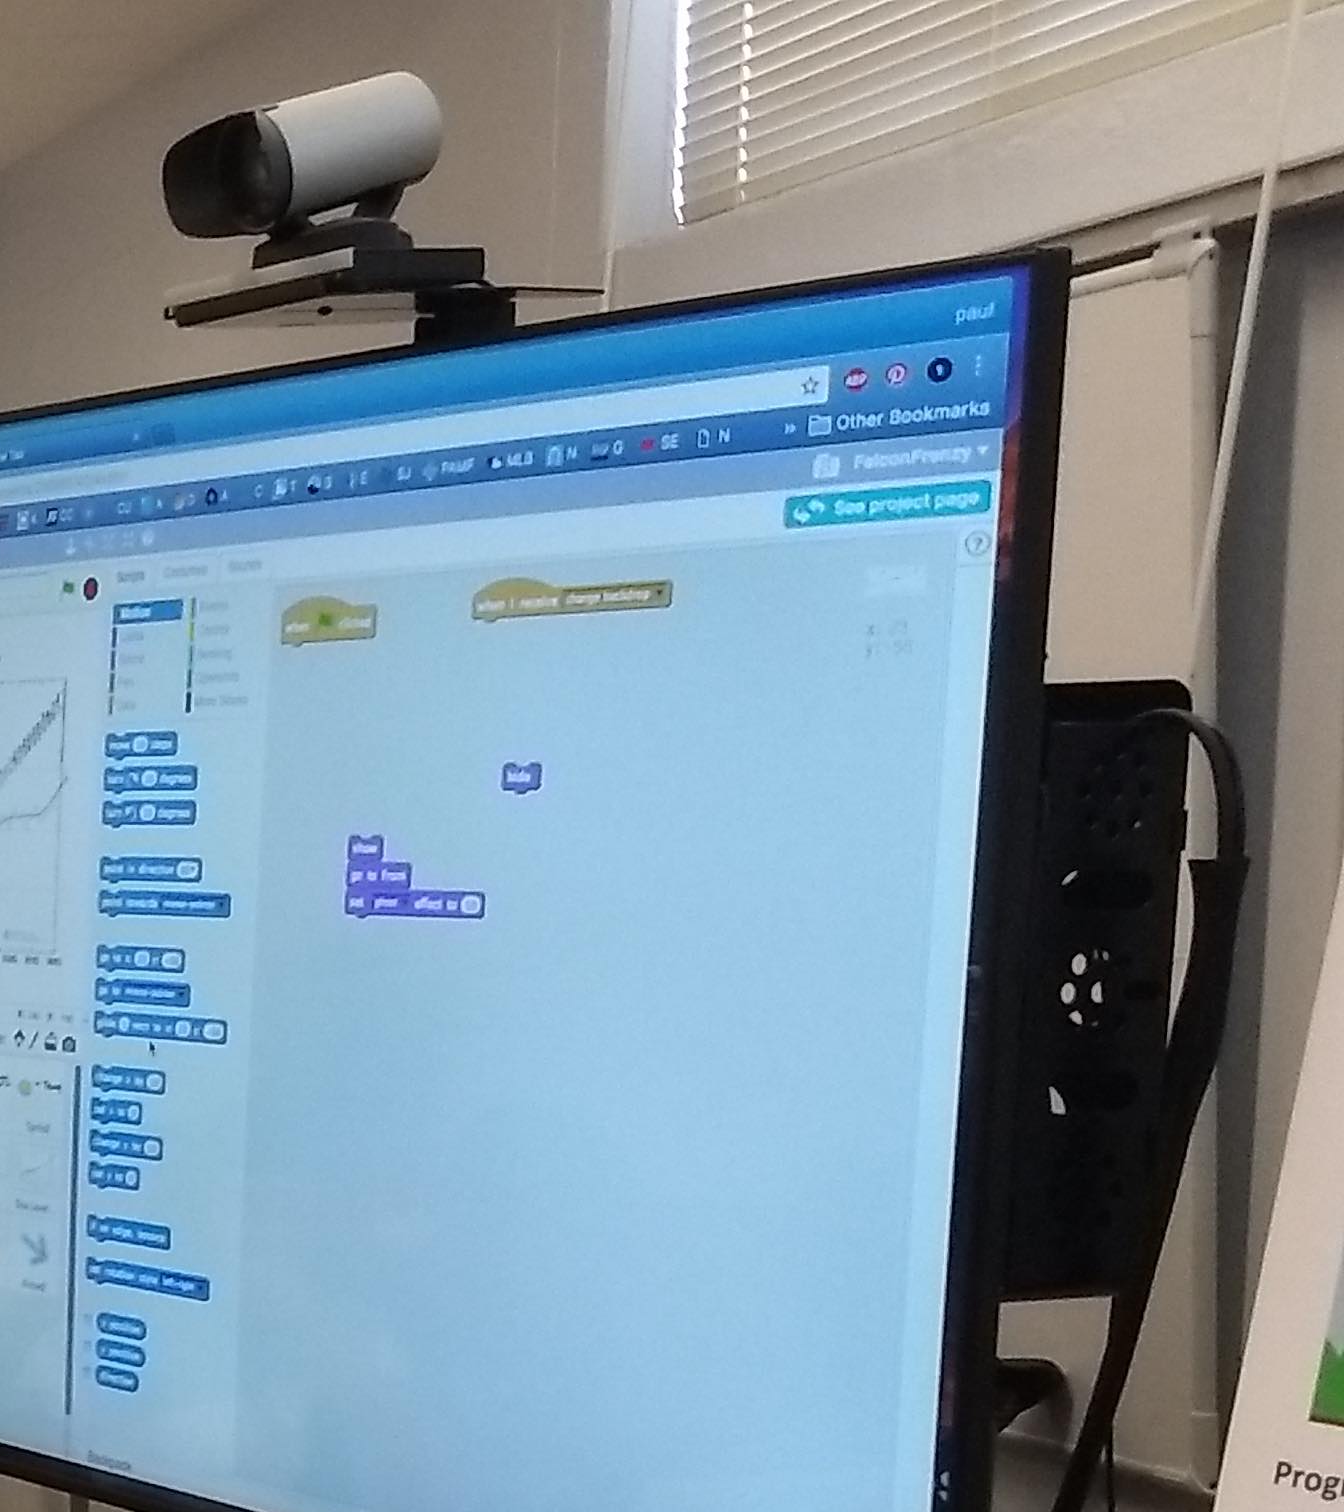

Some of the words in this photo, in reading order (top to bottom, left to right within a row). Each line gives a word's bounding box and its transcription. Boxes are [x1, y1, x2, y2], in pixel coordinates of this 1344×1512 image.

[955, 302, 996, 326] paul
[835, 411, 884, 432] Other
[888, 400, 991, 424] Bookmarks
[661, 432, 679, 449] SE
[718, 428, 731, 444] N
[853, 449, 973, 470] FalconFrenzy
[833, 499, 866, 516] See
[868, 494, 931, 515] project
[933, 491, 981, 510] page
[1273, 1460, 1344, 1501] Prog
